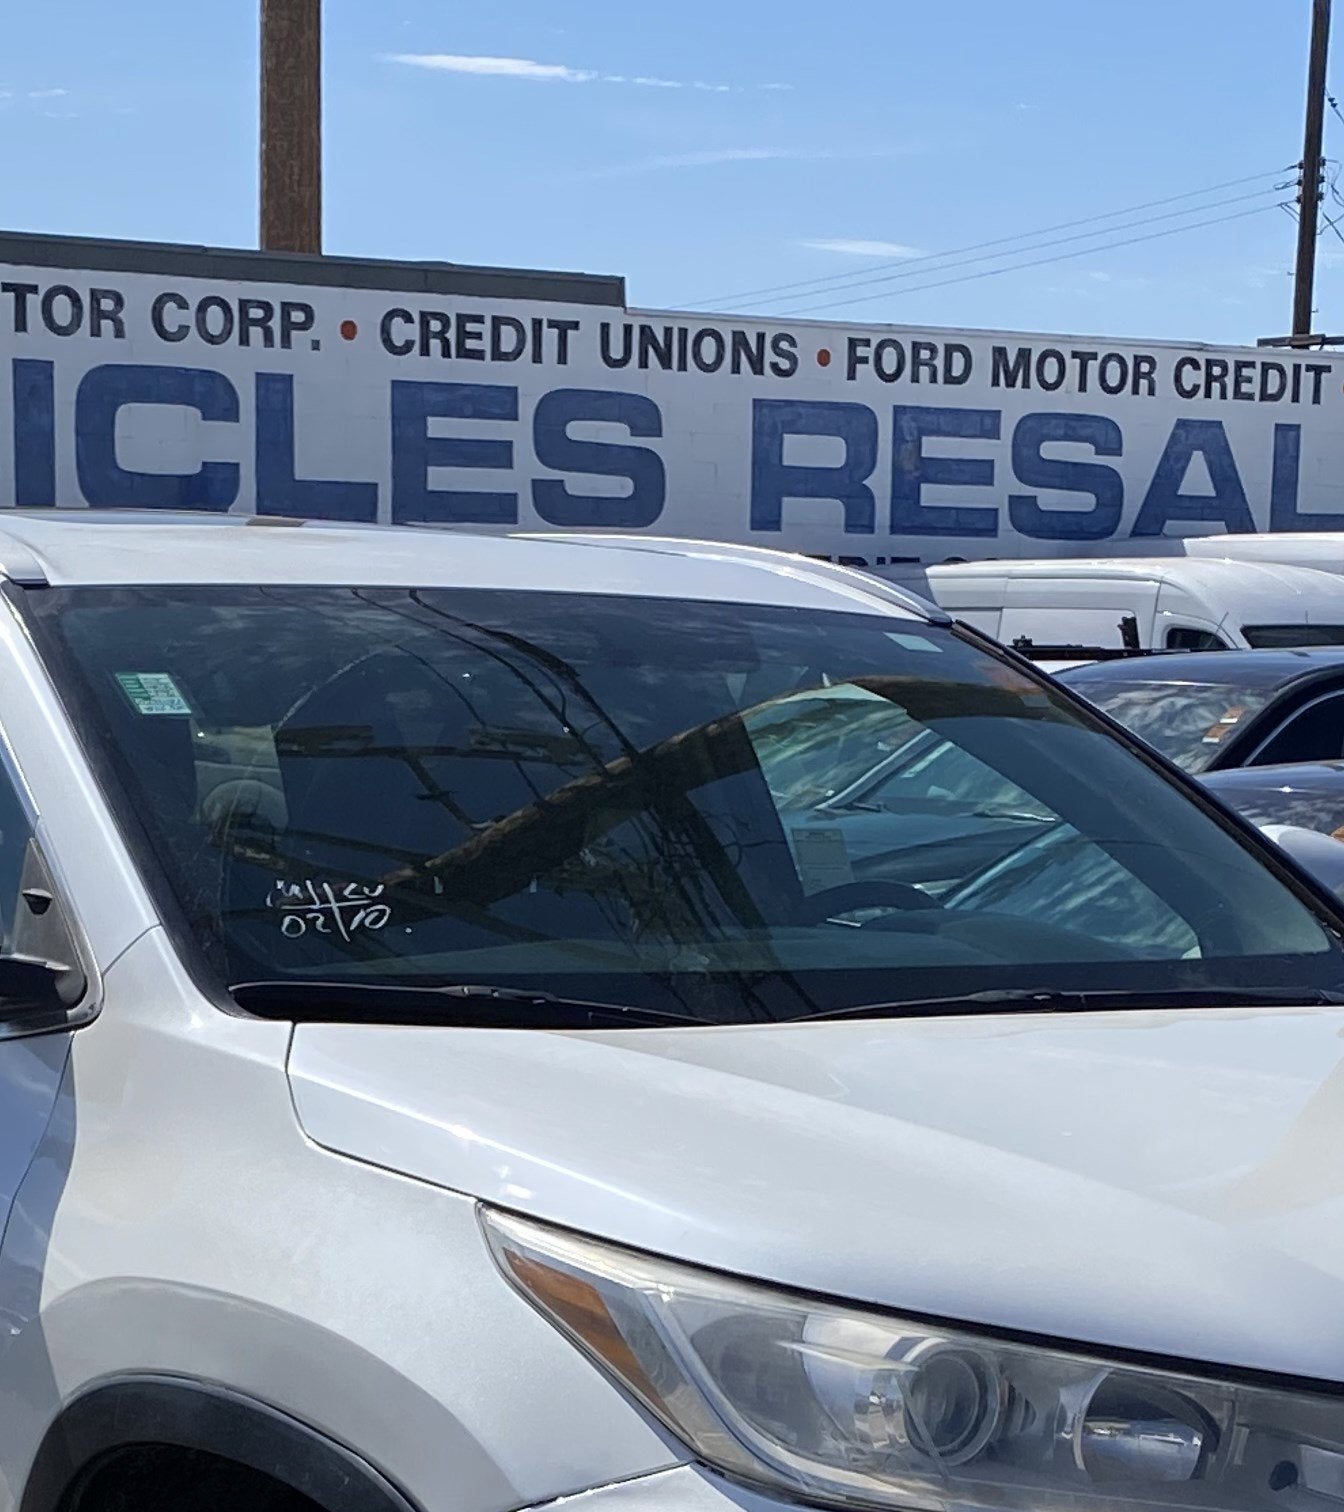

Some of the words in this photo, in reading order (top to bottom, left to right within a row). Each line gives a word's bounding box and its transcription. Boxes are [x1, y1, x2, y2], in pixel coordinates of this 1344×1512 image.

[151, 292, 321, 352] CORP.
[379, 307, 581, 366] CREDIT
[599, 321, 799, 379] UNIONS
[846, 336, 973, 386] FORD
[990, 345, 1157, 397] MOTOR
[1173, 356, 1332, 406] CREDIT
